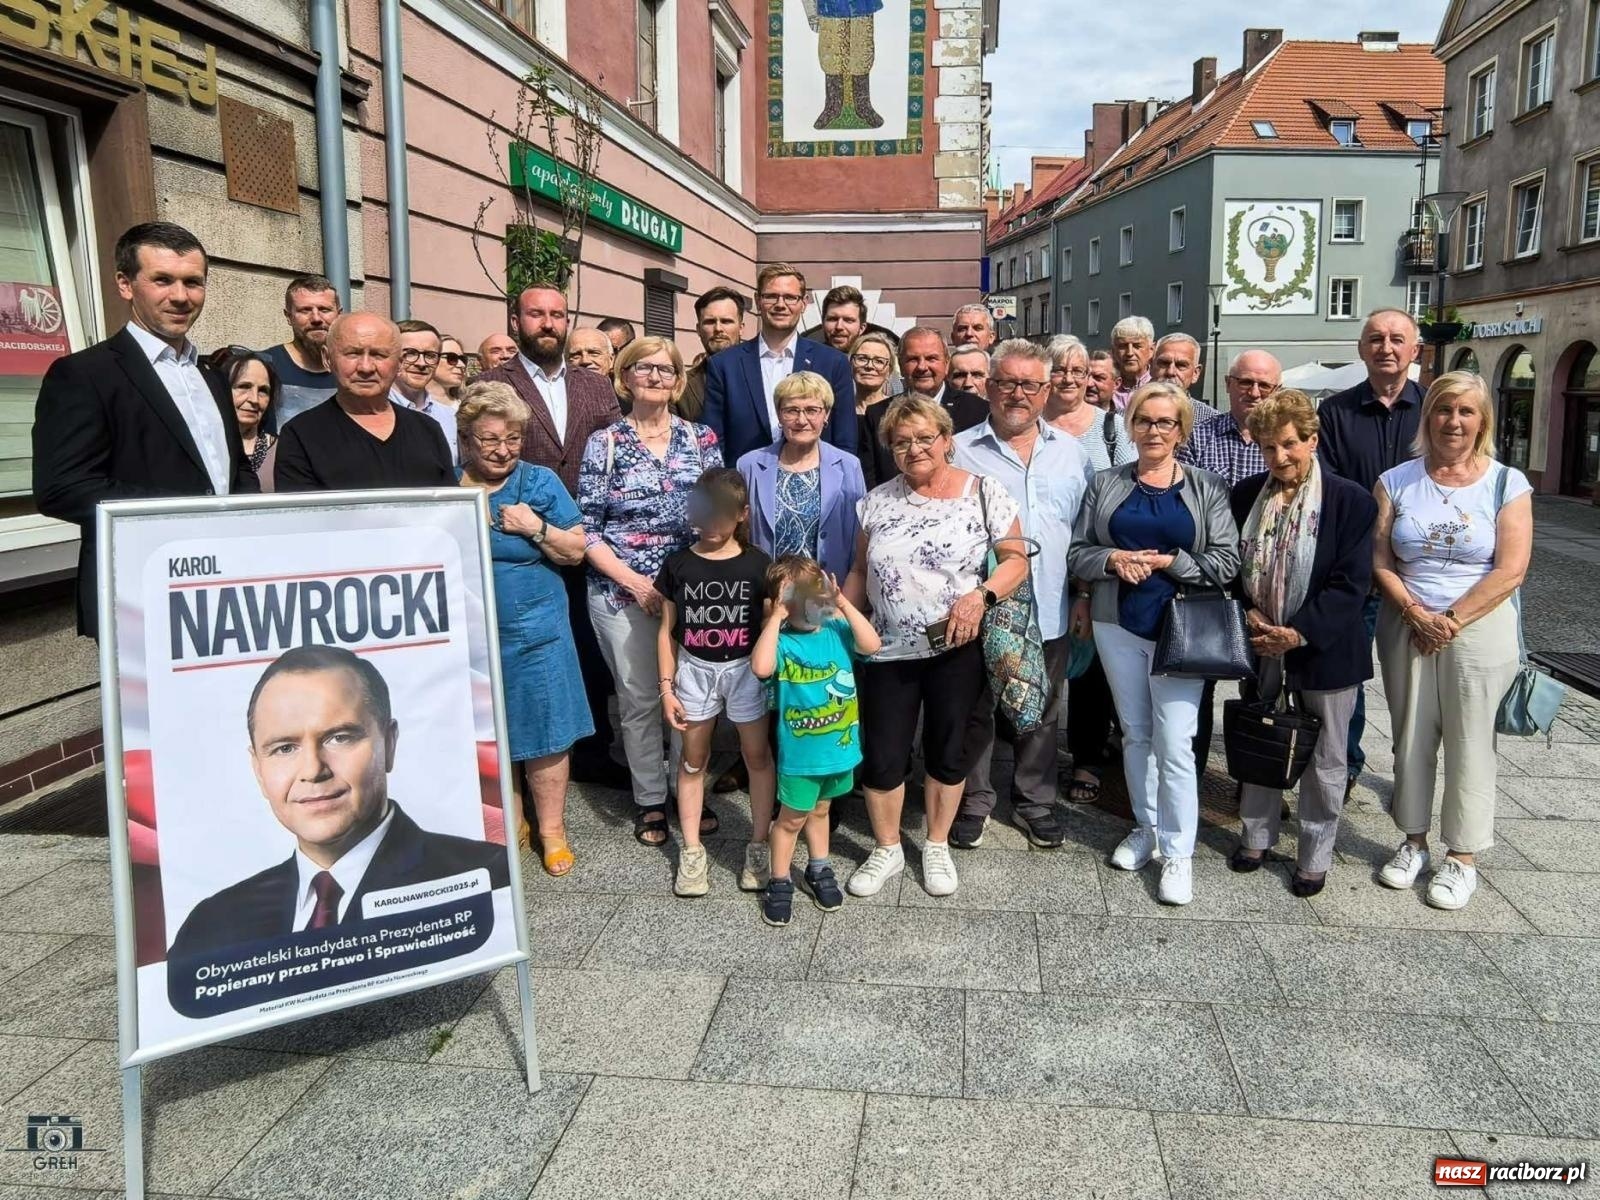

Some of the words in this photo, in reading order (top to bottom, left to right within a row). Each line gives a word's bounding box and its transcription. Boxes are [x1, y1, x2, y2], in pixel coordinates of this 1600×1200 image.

[621, 200, 668, 244] DŁUGA
[670, 226, 678, 247] 7
[1472, 322, 1501, 338] DOBRY
[168, 555, 222, 578] KAROL
[684, 581, 751, 600] MOVE
[168, 570, 450, 660] NAWROCKI
[685, 605, 750, 624] MOVE
[684, 627, 750, 648] MOVE
[374, 879, 479, 908] KAROLNAWROCKI2025.pl
[195, 948, 292, 981] Obywatelski
[295, 936, 358, 958] kandydat
[361, 934, 377, 945] na
[380, 917, 452, 941] Prezydenta
[455, 910, 473, 925] RP
[195, 972, 276, 1000] Popierany
[279, 962, 319, 982] przez
[322, 953, 365, 970] Prawo
[367, 949, 372, 960] i
[375, 924, 477, 959] Sprawiedliwość
